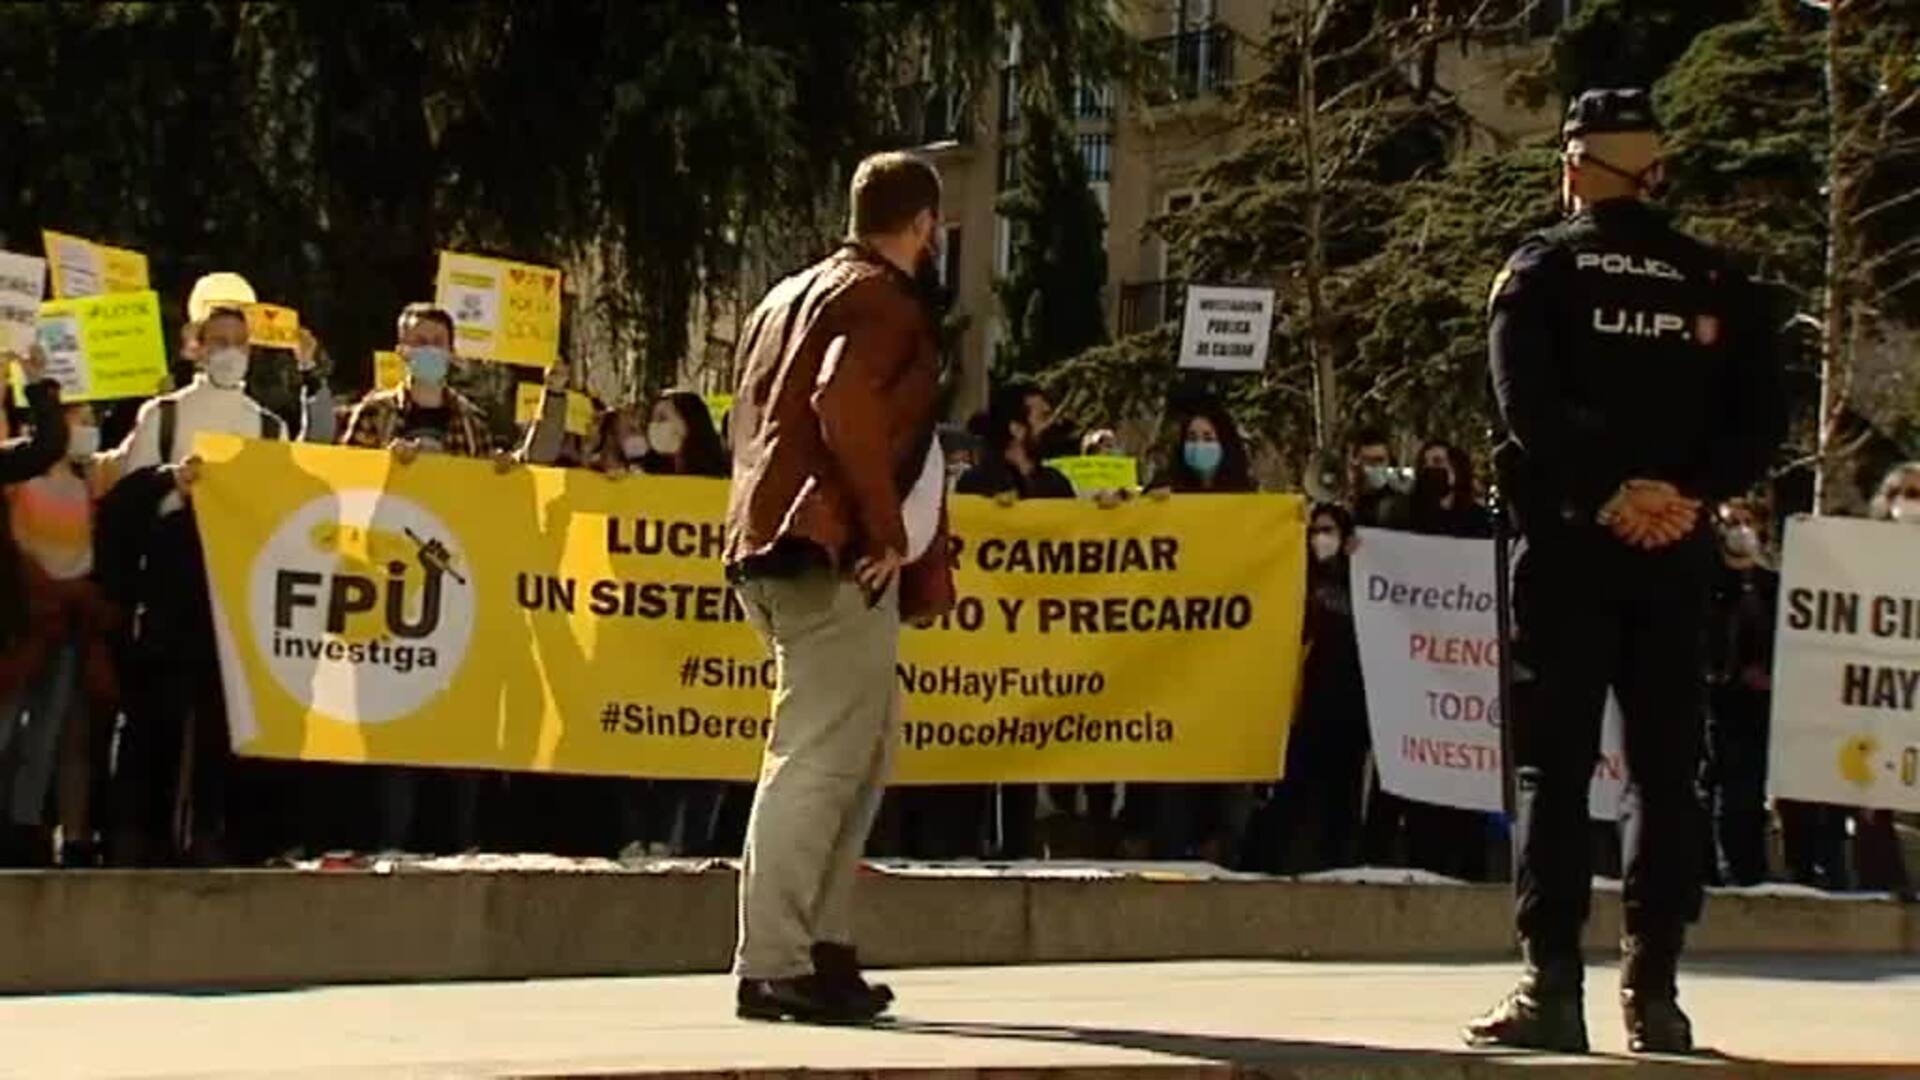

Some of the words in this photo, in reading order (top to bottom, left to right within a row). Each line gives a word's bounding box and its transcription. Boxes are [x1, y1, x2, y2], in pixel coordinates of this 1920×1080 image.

[1594, 308, 1690, 340] U.I.P.
[607, 517, 725, 559] LUCH
[977, 537, 1178, 573] CAMBIAR
[274, 555, 443, 639] FPU
[517, 572, 576, 613] UN
[589, 579, 745, 621] SISTEM
[1000, 599, 1024, 632] Y
[1038, 595, 1253, 633] PRECARIO
[1368, 575, 1498, 612] Derecho
[1788, 588, 1859, 634] SIN
[274, 632, 437, 673] investiga
[1843, 663, 1920, 710] HAY
[1401, 734, 1497, 770] INVESTI
